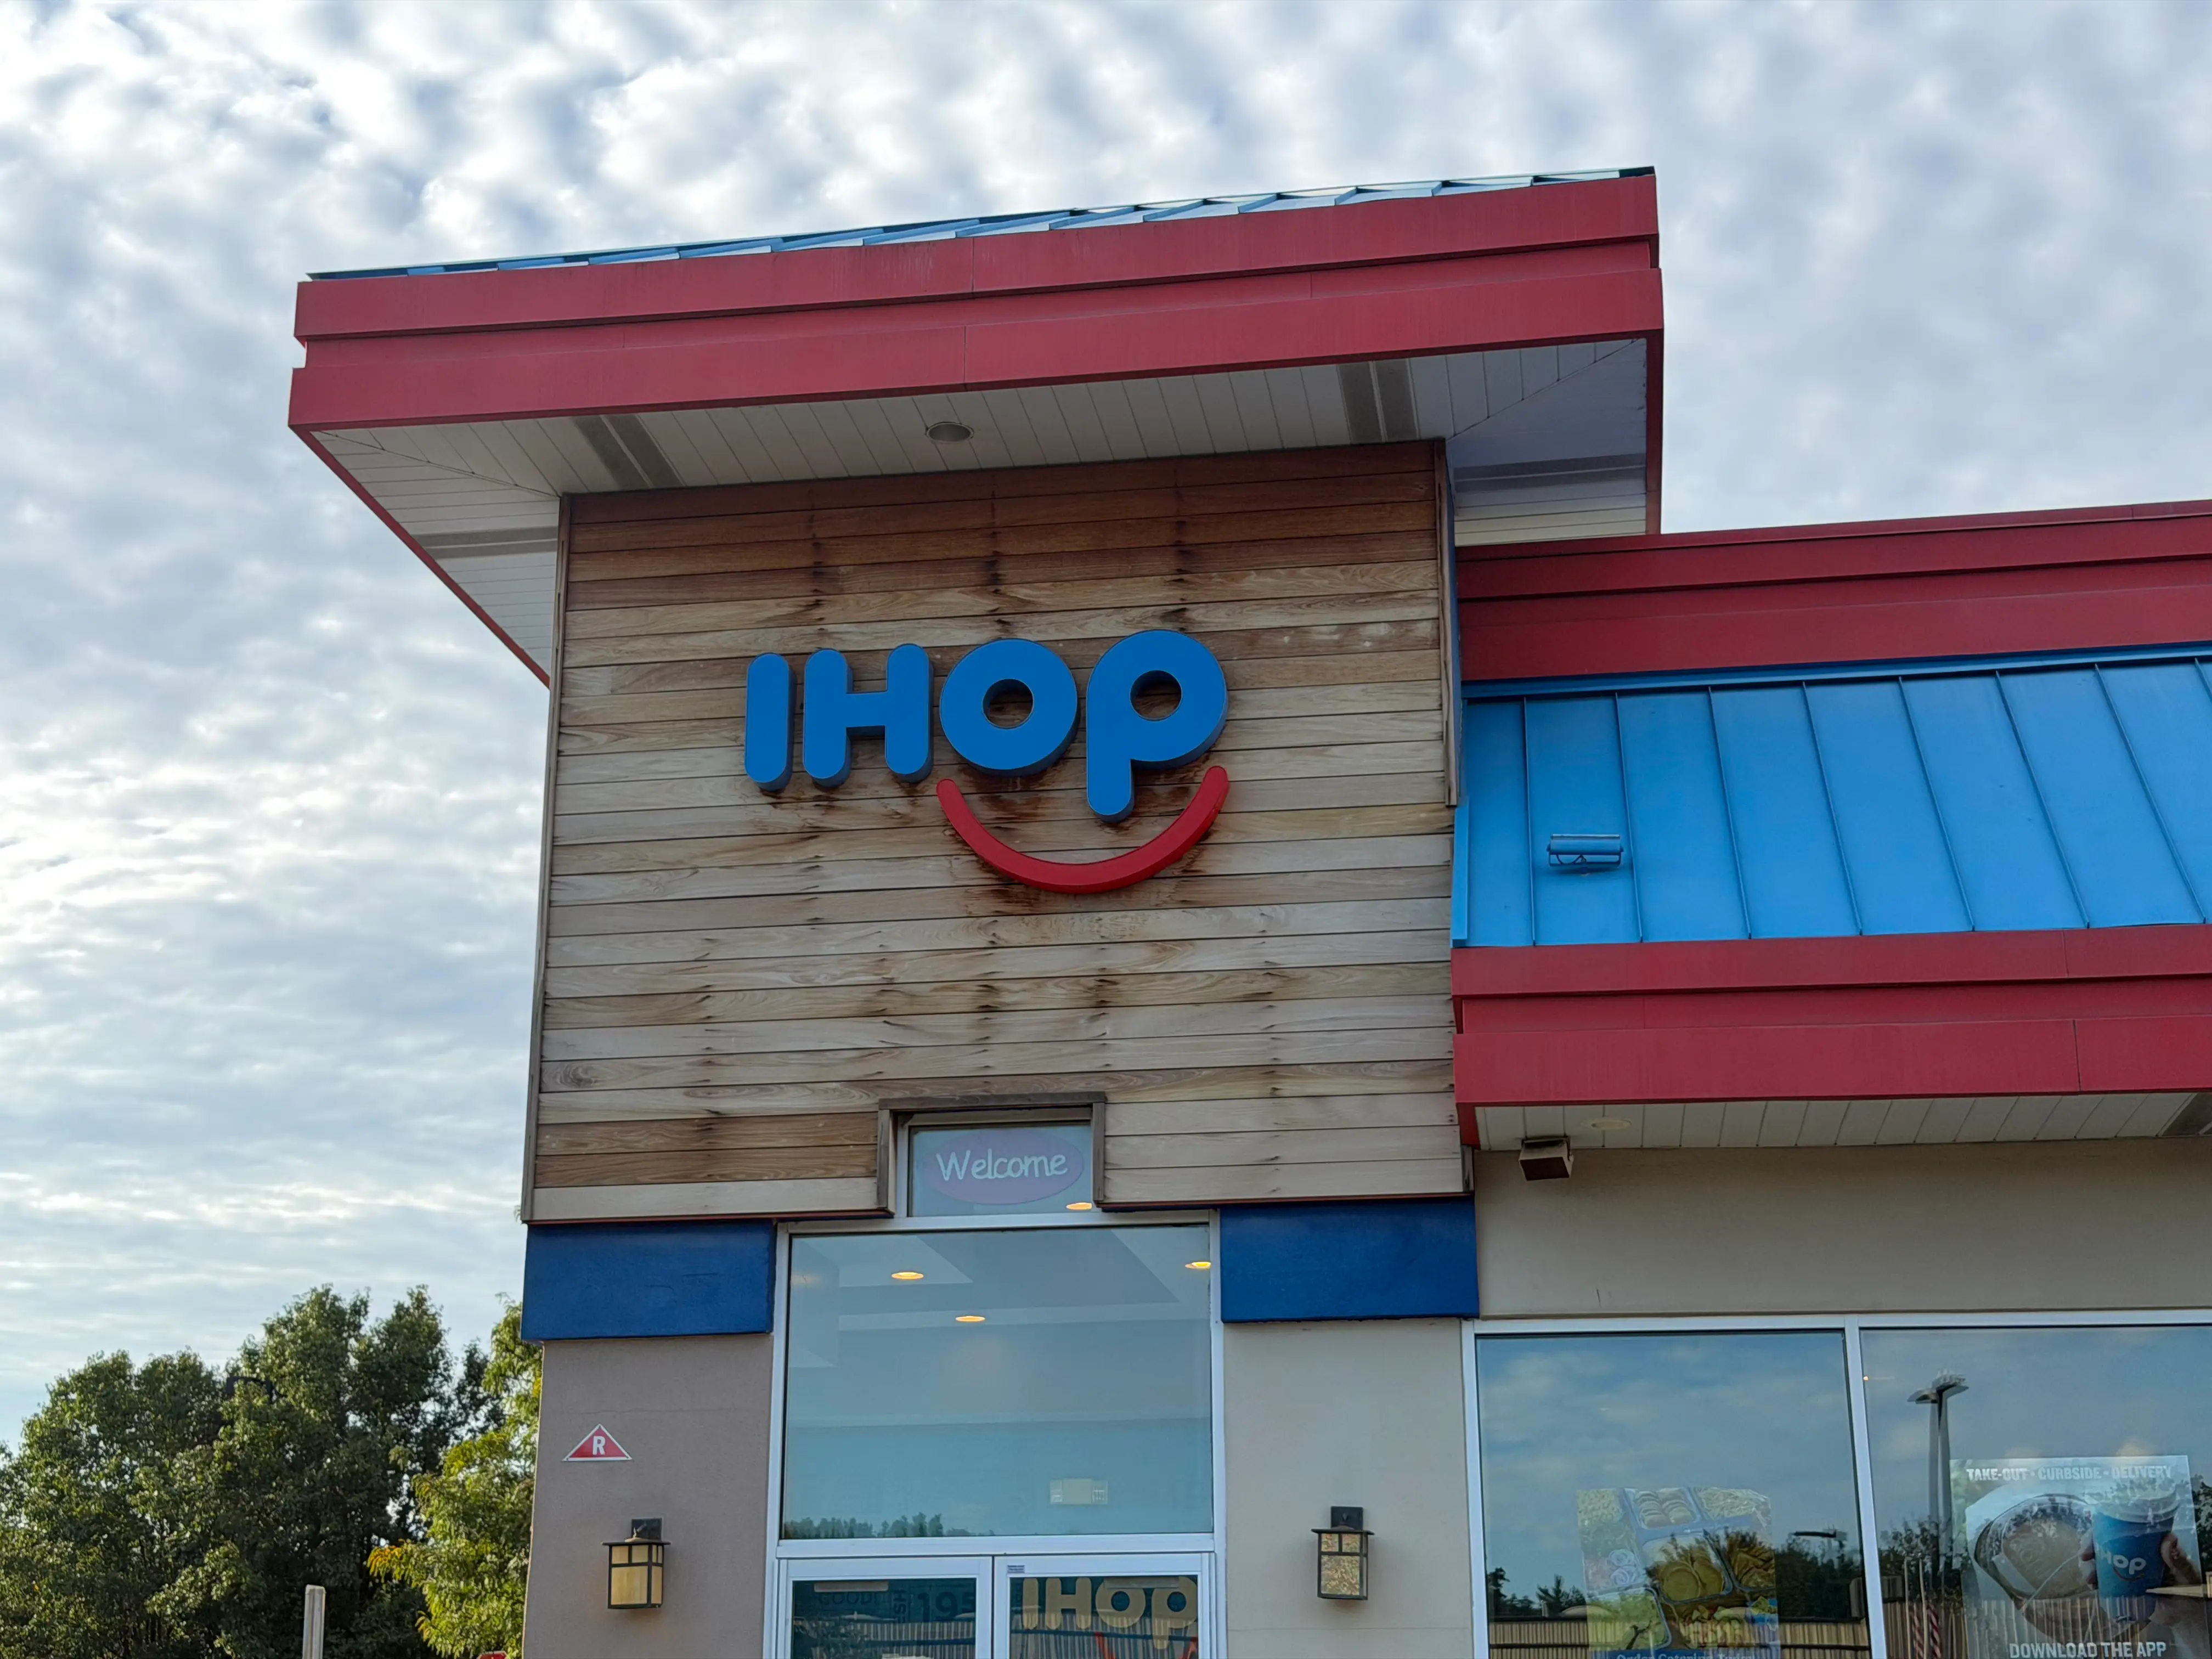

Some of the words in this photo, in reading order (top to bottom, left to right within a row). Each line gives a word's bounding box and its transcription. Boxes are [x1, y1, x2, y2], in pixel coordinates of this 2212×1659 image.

[744, 629, 1228, 823] IHOP
[935, 1148, 1068, 1181] Welcome
[592, 1436, 606, 1455] R
[1966, 1468, 2028, 1481] TAKE-OUT
[2038, 1466, 2102, 1481] CURBSIDE
[2112, 1465, 2172, 1480] DELIVERY
[2009, 1641, 2098, 1658] DOWNLOAD
[2101, 1641, 2133, 1658] THE
[2136, 1641, 2166, 1658] APP
